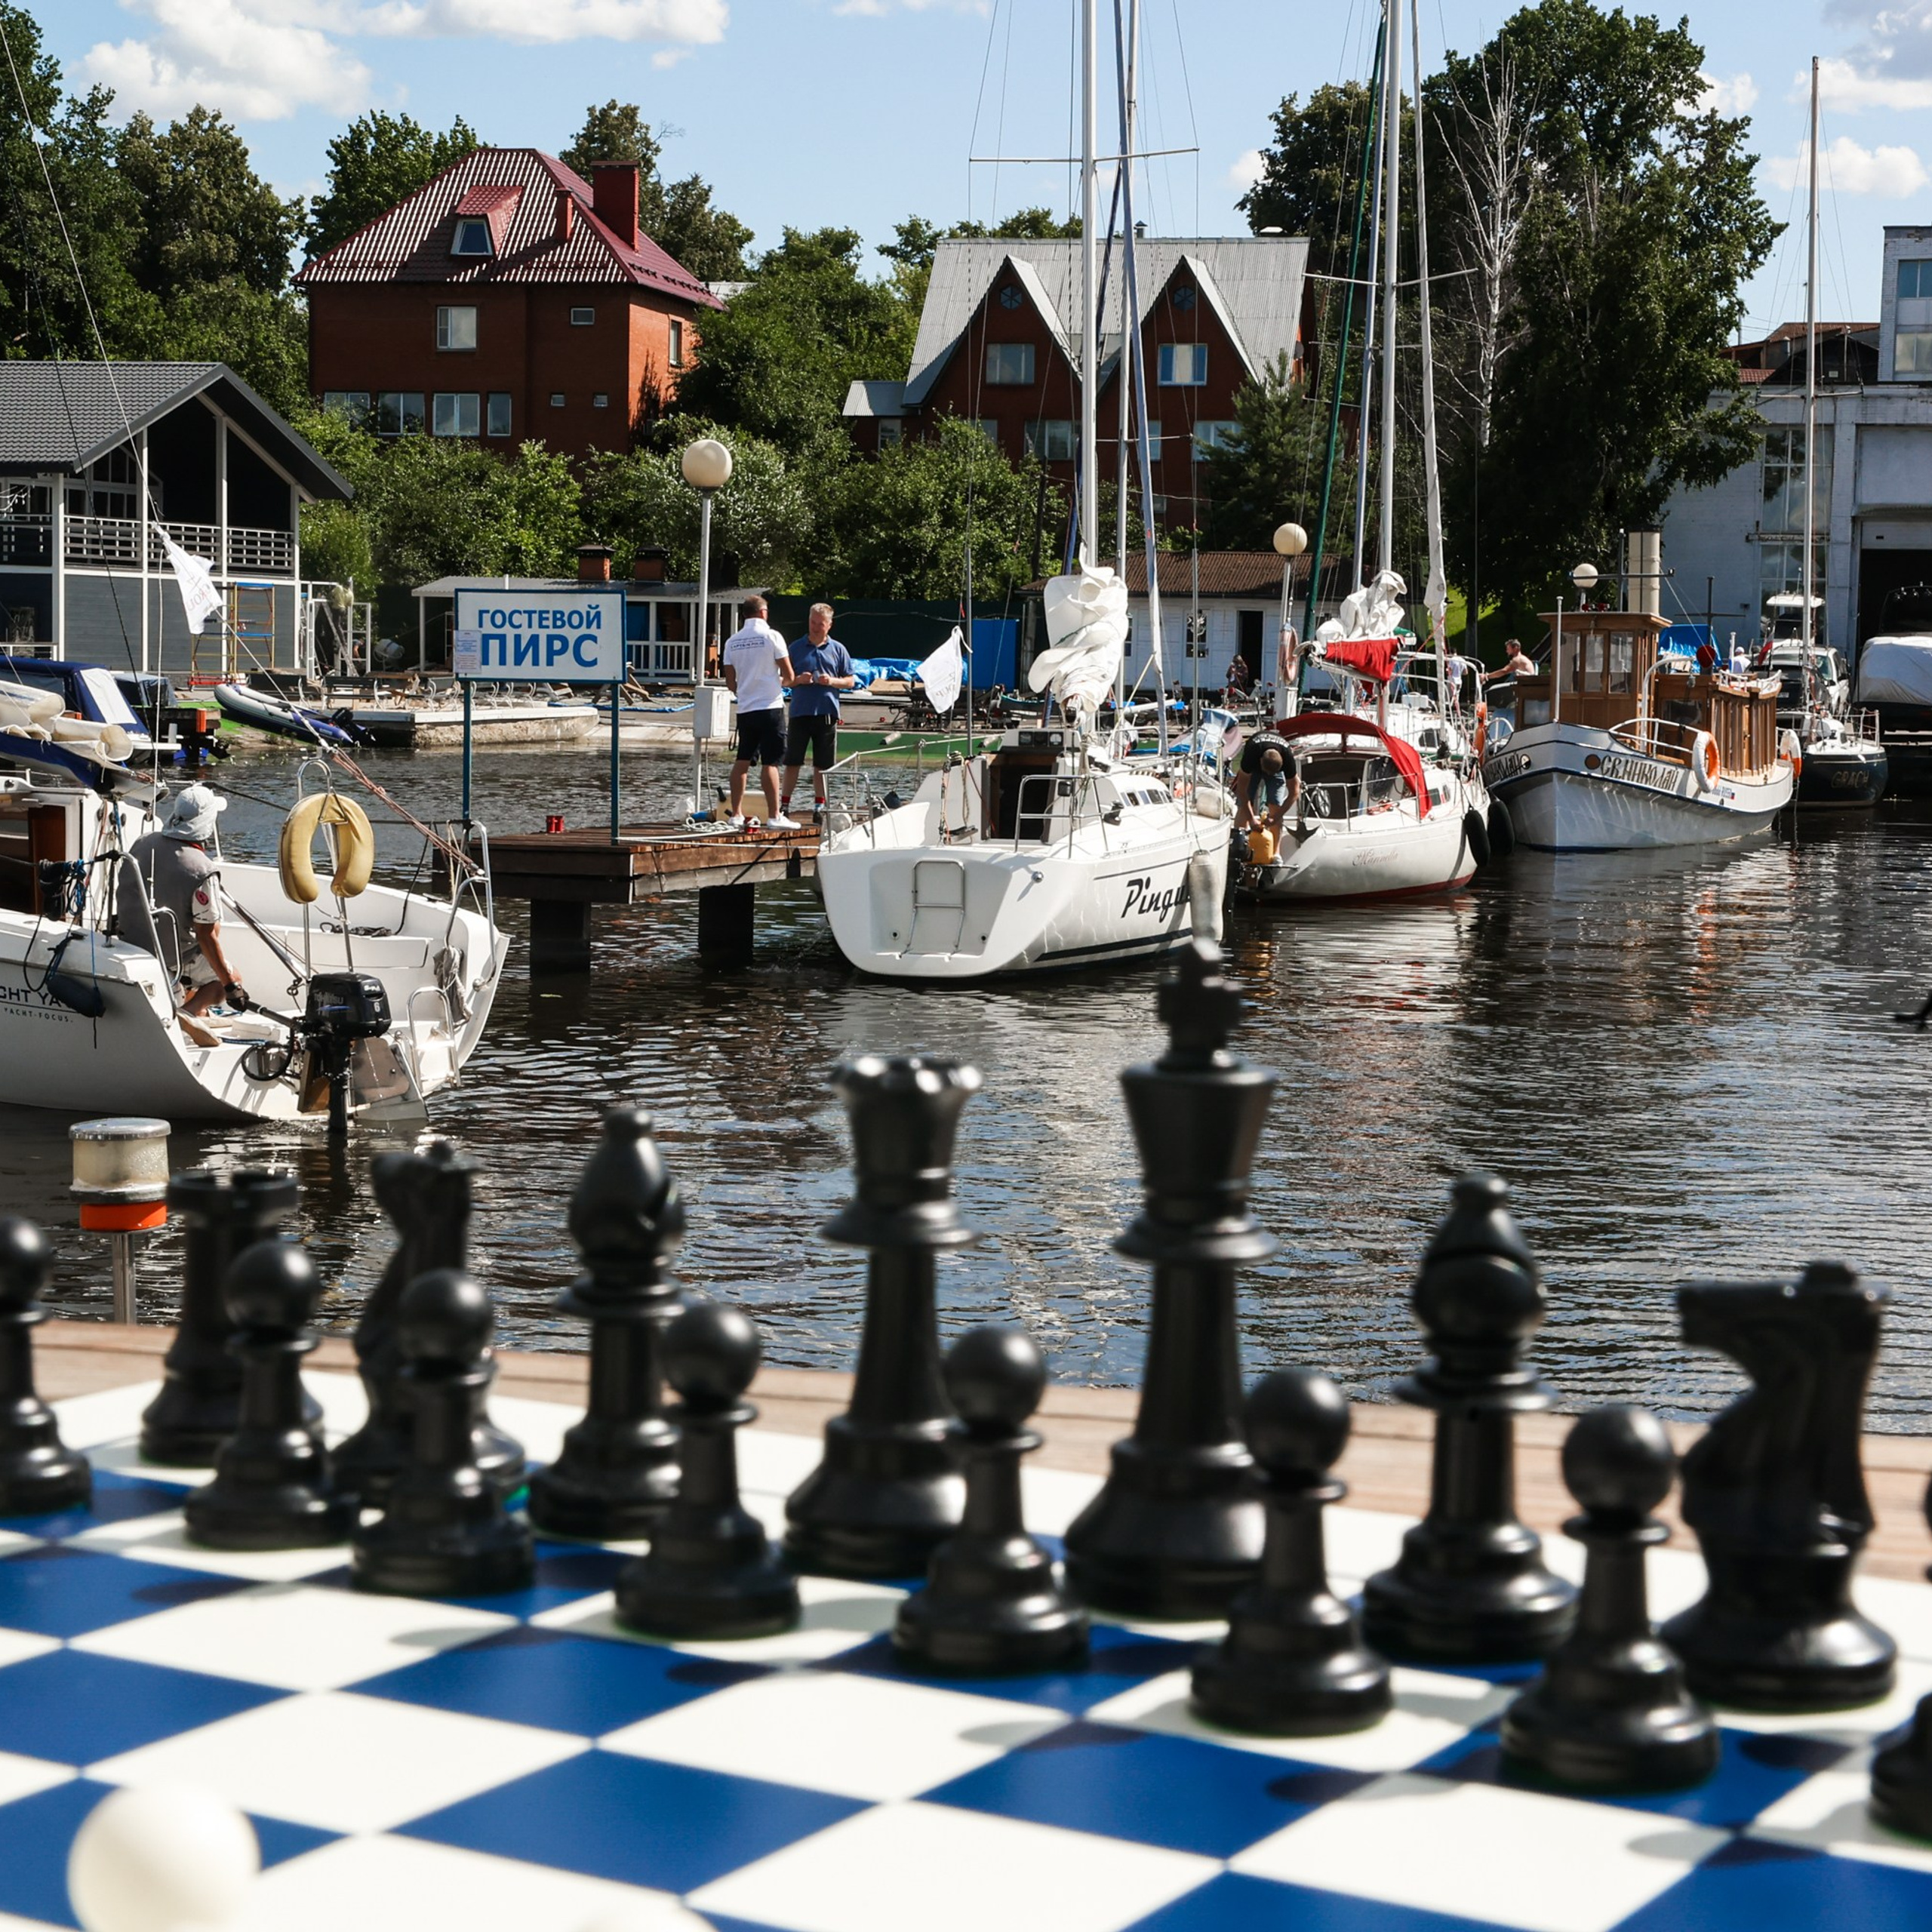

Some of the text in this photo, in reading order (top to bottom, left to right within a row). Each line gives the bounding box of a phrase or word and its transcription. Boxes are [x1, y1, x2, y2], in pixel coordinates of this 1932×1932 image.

[478, 604, 602, 630] ГОСТЕВОЙ
[481, 633, 598, 668] ПИРС
[374, 1001, 381, 1013] 6
